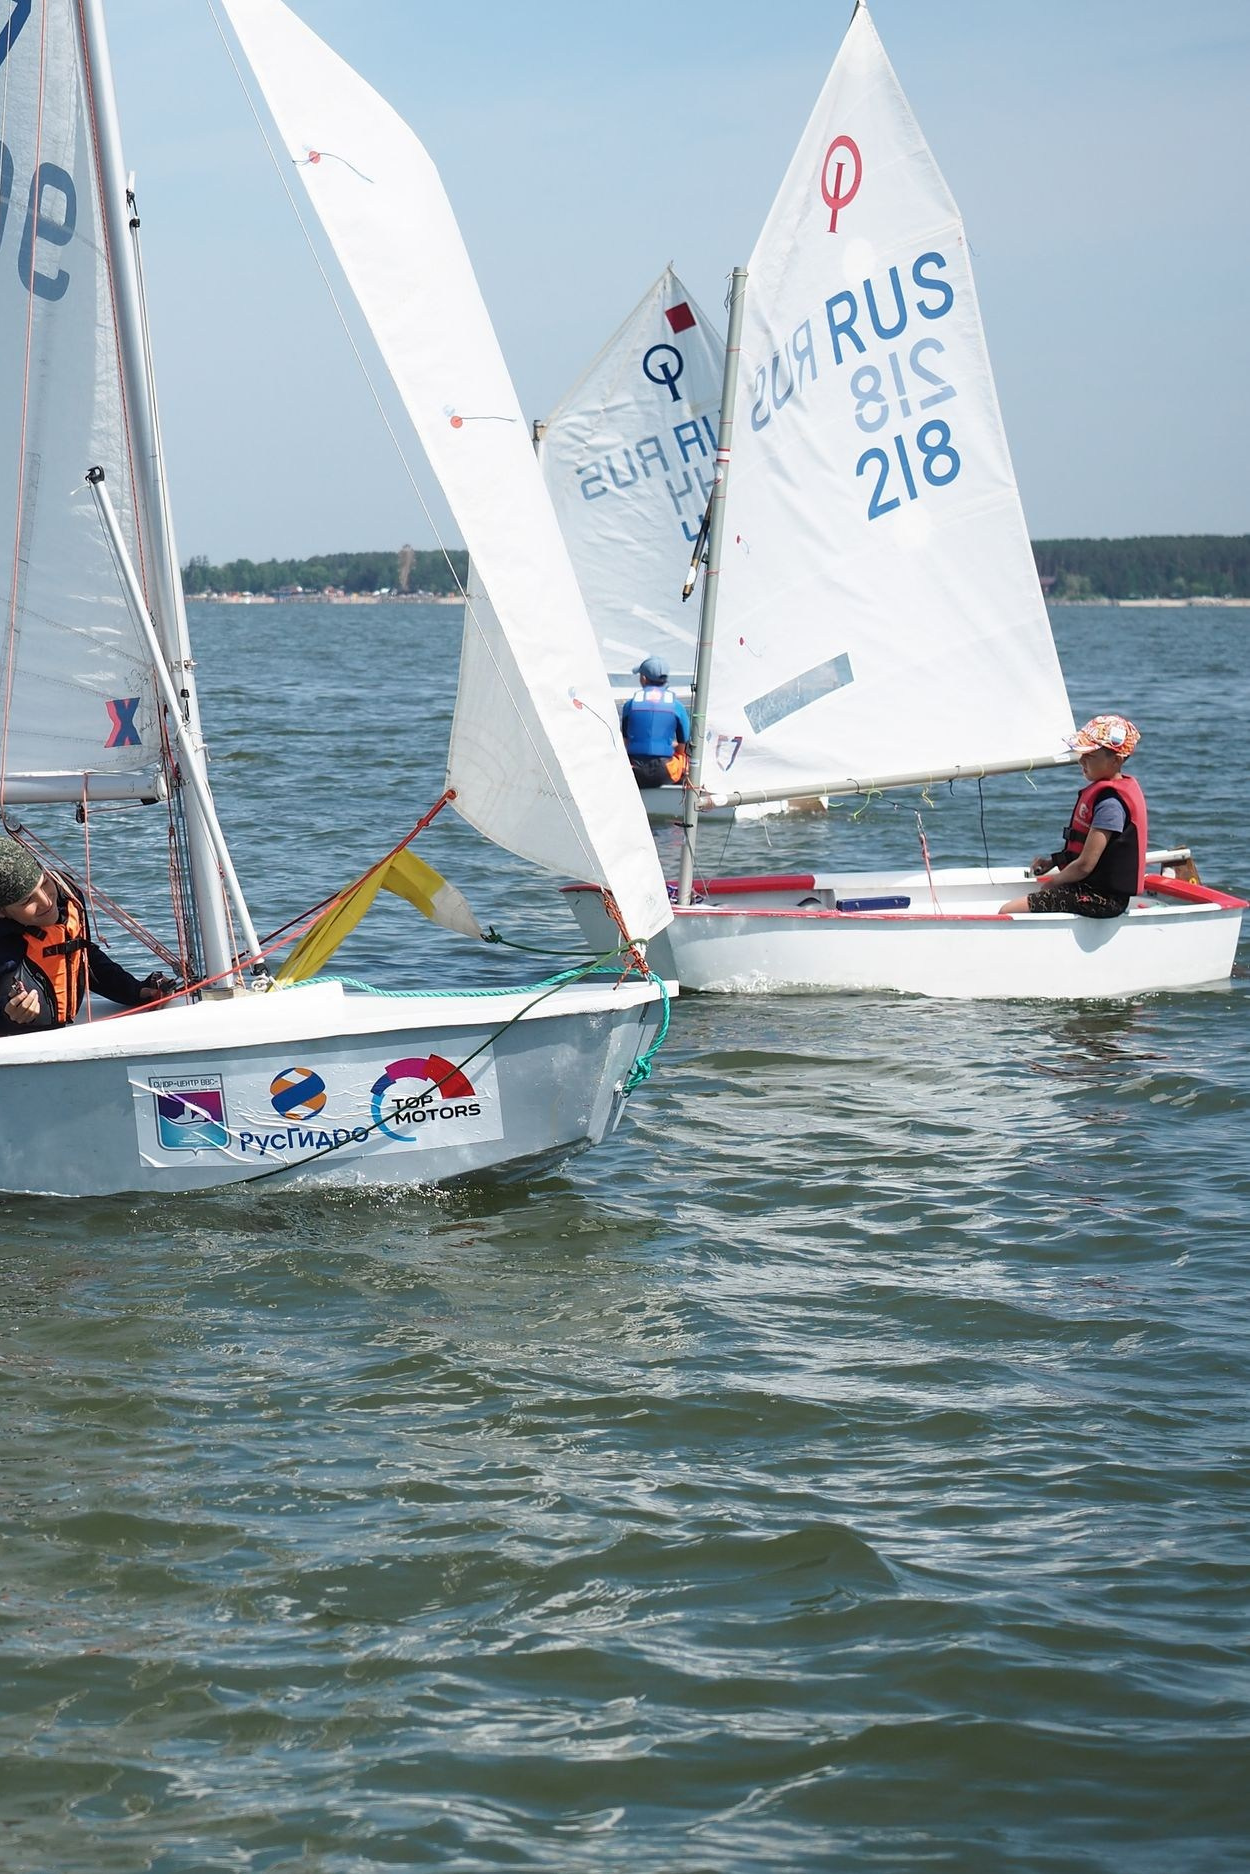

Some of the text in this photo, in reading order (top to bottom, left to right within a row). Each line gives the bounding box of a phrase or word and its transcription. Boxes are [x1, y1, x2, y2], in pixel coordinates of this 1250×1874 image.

[825, 251, 954, 366] RUS
[855, 419, 961, 521] 218
[392, 1094, 433, 1110] TOP
[394, 1103, 481, 1125] MOTORS
[239, 1126, 370, 1156] РусГидро
